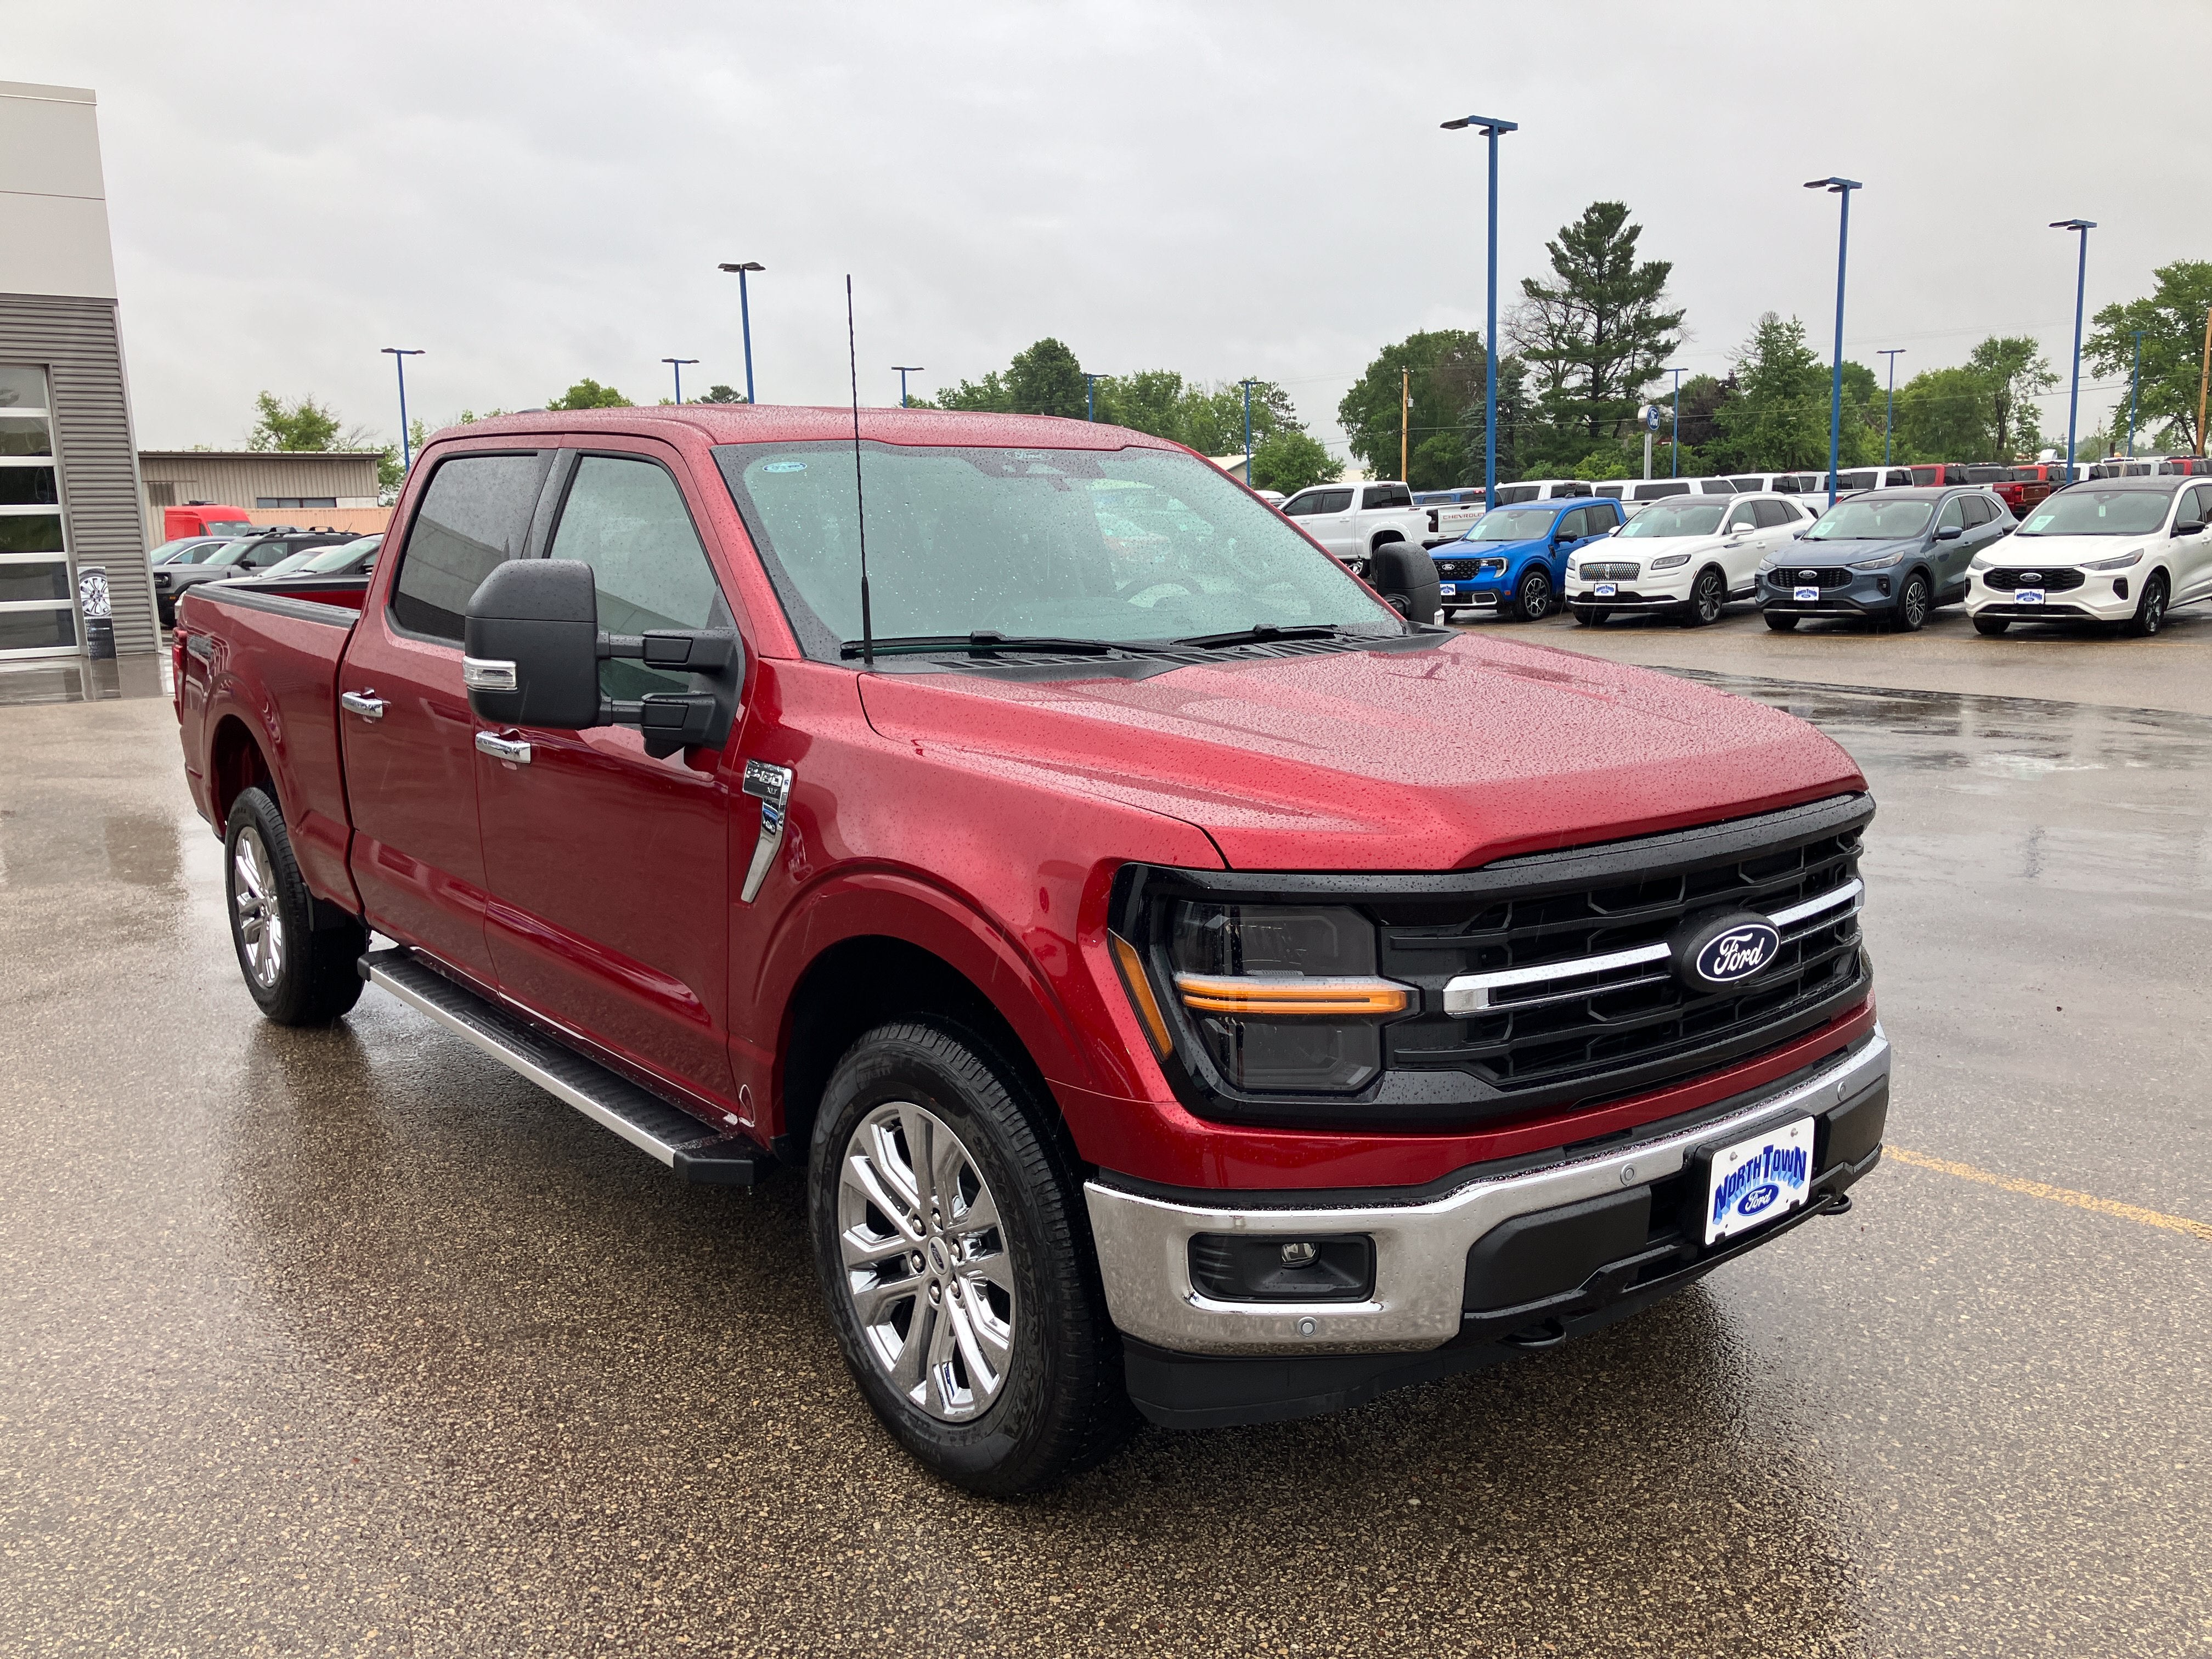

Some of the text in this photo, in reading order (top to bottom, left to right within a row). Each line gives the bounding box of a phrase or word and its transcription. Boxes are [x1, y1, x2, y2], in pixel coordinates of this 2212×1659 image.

[1713, 933, 1765, 975] Ford
[1713, 1144, 1807, 1225] NORTH TOWN
[1745, 1188, 1772, 1211] Ford
